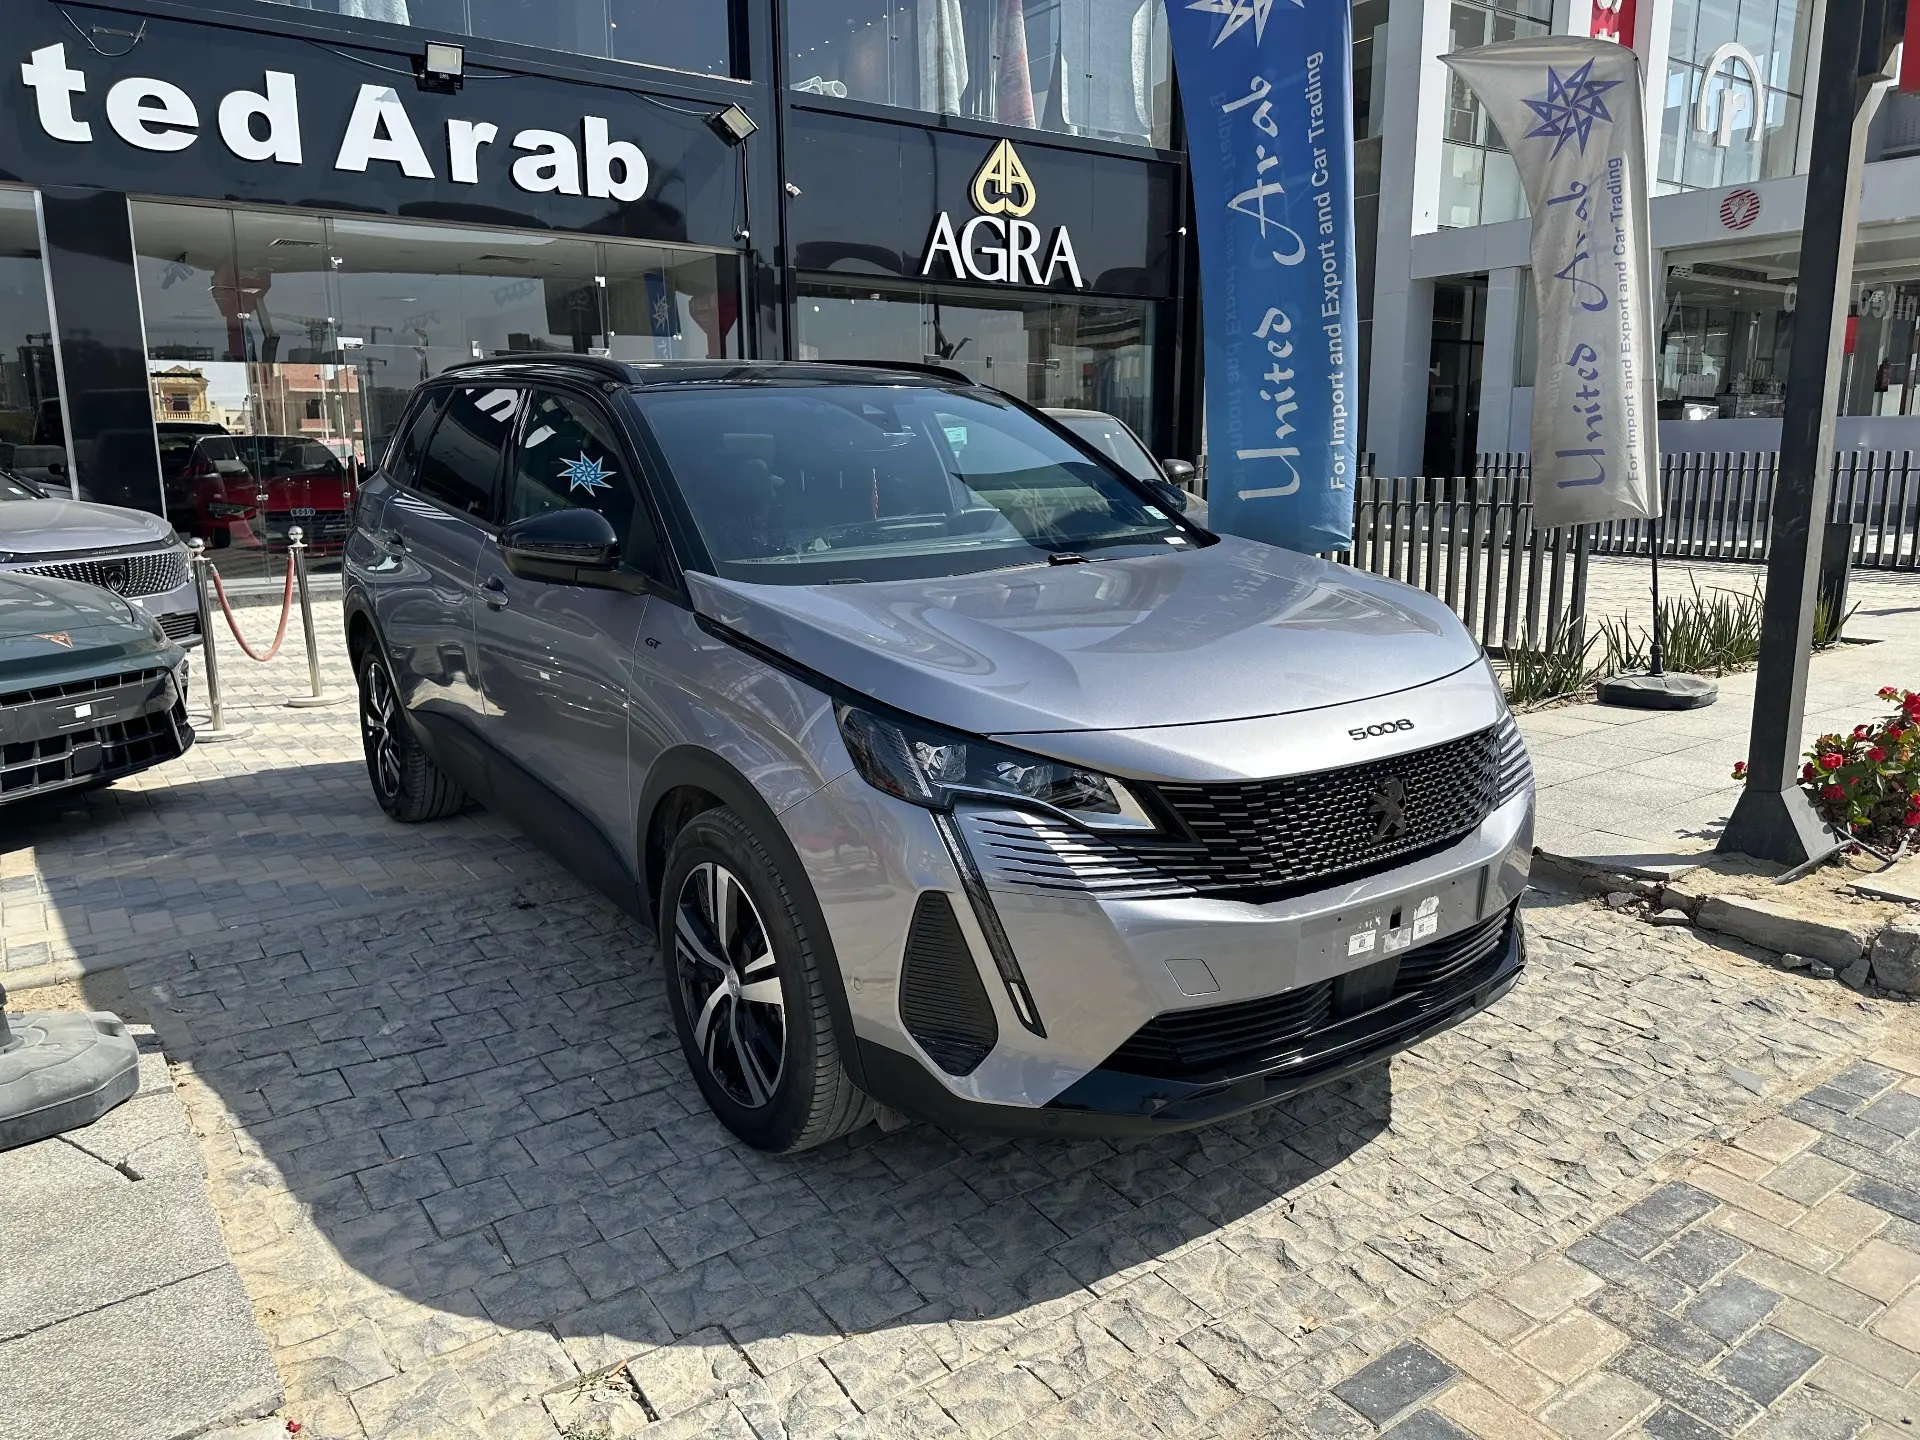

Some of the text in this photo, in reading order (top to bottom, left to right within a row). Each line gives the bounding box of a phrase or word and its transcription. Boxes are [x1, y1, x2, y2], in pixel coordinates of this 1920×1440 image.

[21, 42, 650, 202] ted Arab
[1222, 75, 1305, 266] Arab
[921, 211, 1084, 288] AGRA
[1305, 51, 1348, 490] For Import and Export and Car Trading
[1546, 181, 1608, 312] Arab
[1606, 157, 1638, 482] For Import and Export and Car Trading
[645, 637, 662, 649] GT
[1348, 719, 1414, 740] 5008
